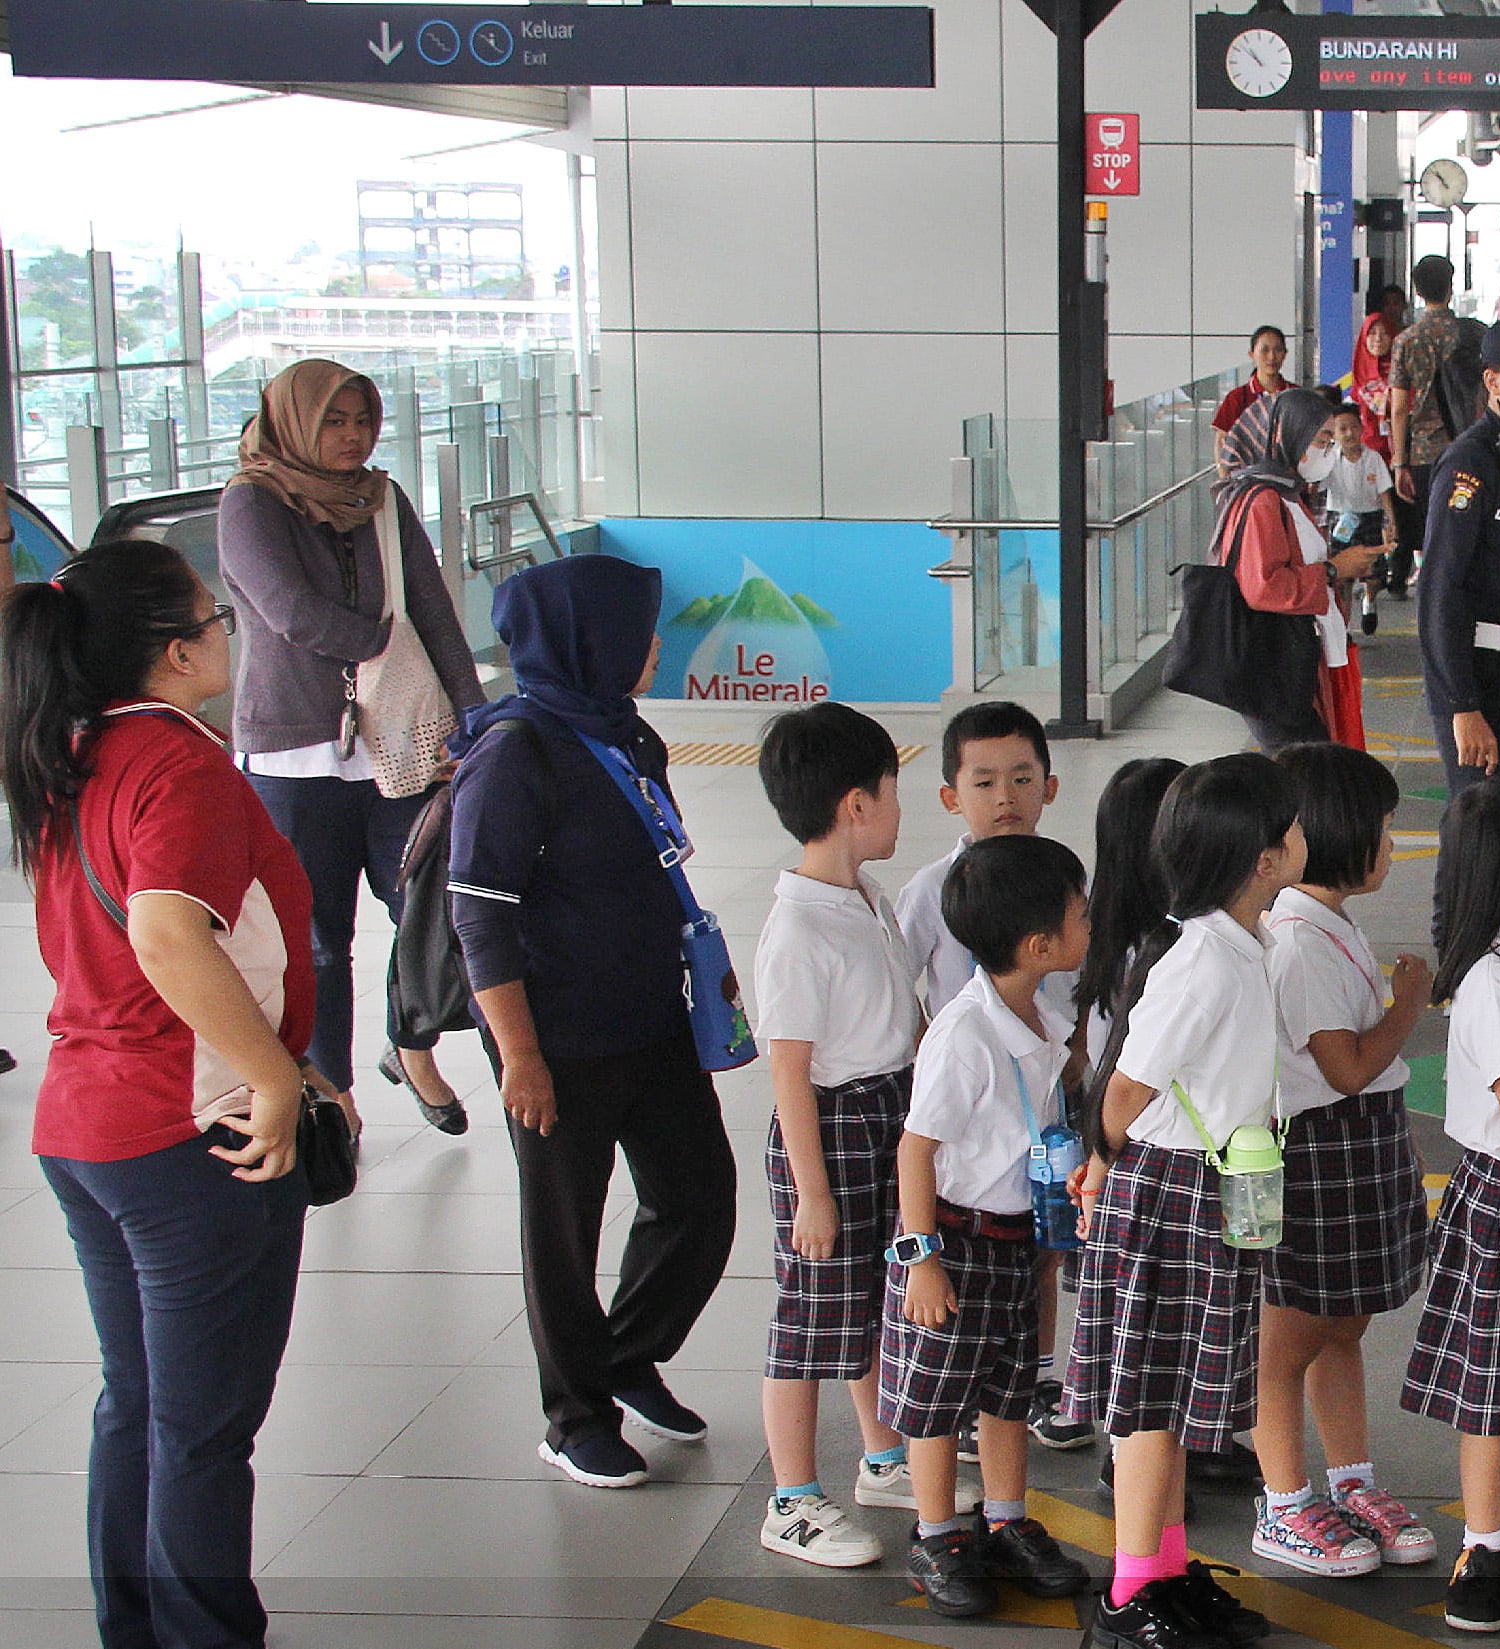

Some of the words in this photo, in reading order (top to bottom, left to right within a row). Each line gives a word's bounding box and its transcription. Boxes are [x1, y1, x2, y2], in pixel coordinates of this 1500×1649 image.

[522, 20, 575, 39] Keluar
[524, 51, 548, 66] Exit
[1320, 40, 1432, 60] BUNDARAN
[1438, 42, 1457, 60] HI
[1370, 69, 1407, 87] any
[1424, 66, 1473, 84] item
[1092, 153, 1132, 169] STOP
[736, 643, 775, 677] Le
[687, 673, 829, 702] Minerale
